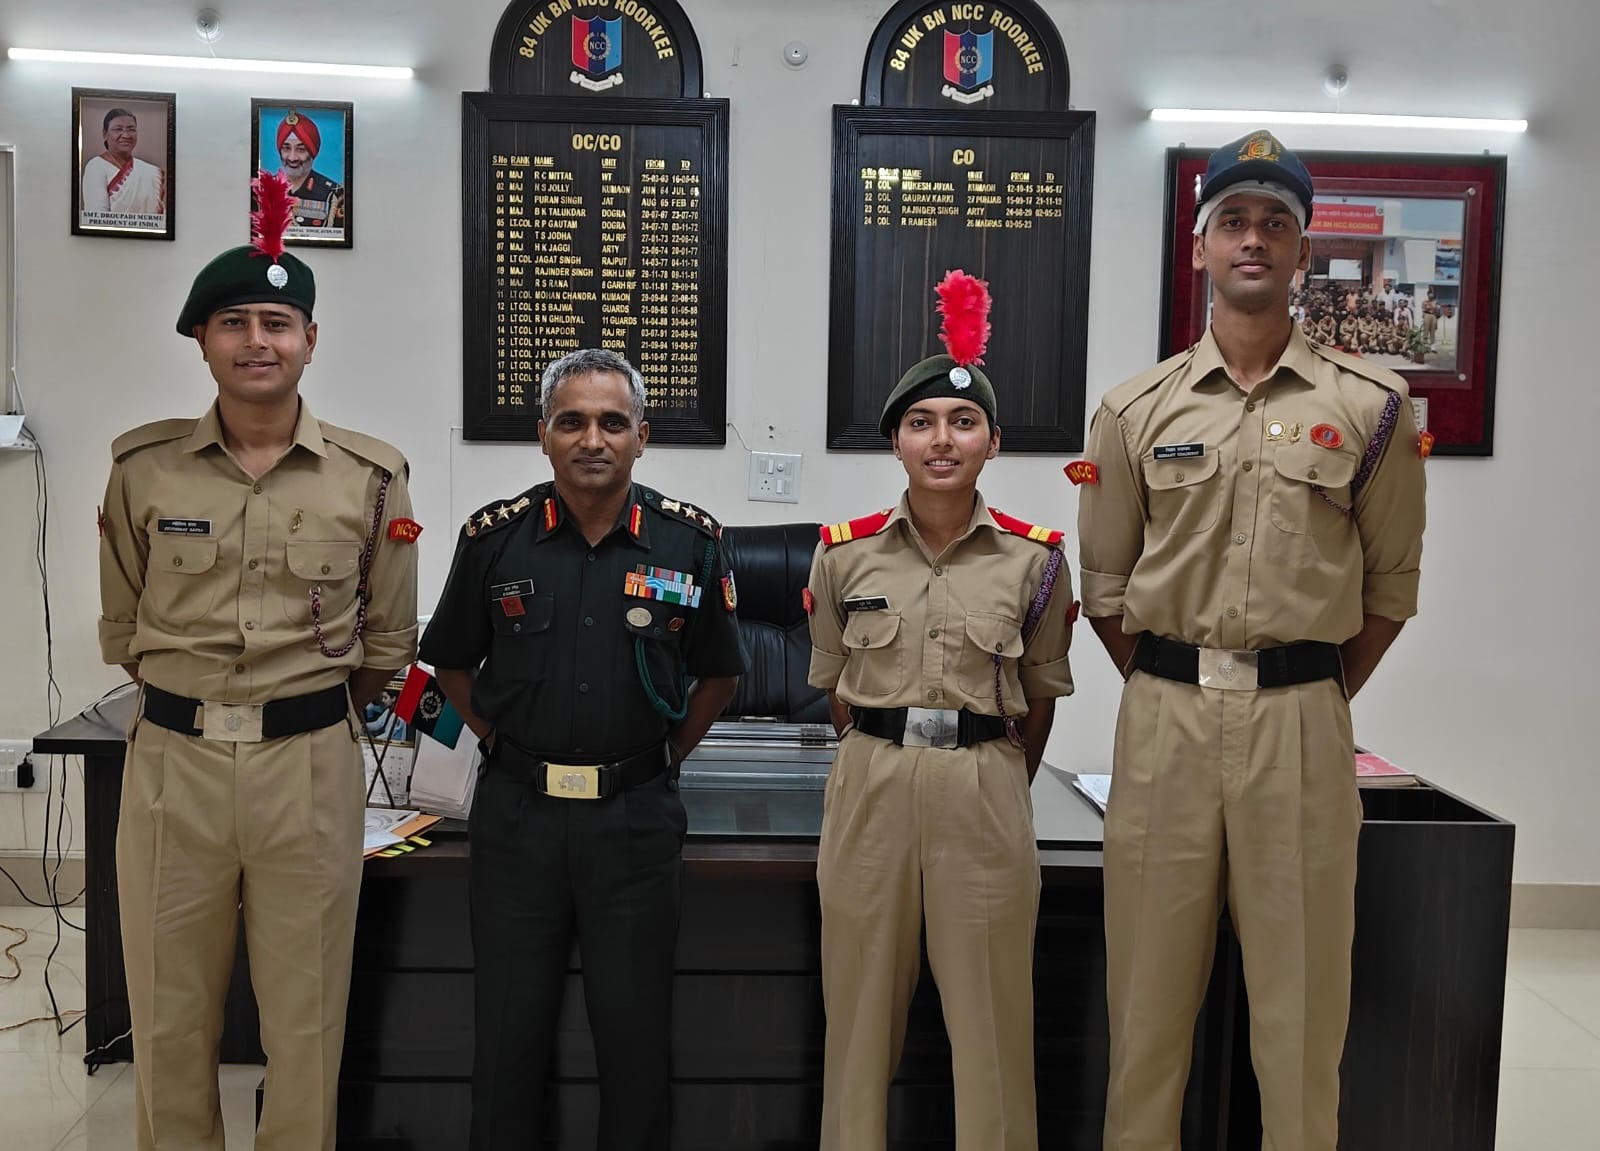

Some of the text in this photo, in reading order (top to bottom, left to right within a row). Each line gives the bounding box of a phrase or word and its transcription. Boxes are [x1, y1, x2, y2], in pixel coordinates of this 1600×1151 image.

[519, 0, 674, 60] 84 UK BN ROORKEE
[890, 4, 1044, 74] 84 UK BN NCC ROORKEE
[590, 41, 606, 50] NCC
[961, 55, 976, 63] NCC
[572, 134, 621, 151] OC/CO
[511, 156, 690, 170] RANK NAME FROM TO
[953, 150, 974, 165] CO
[496, 170, 613, 181] 01 MAJ R C MITTAL WT
[903, 169, 1030, 181] NAME FROM
[496, 182, 504, 191] 02
[509, 182, 523, 191] MAJ
[542, 184, 546, 192] S
[548, 184, 570, 192] JOLLY
[642, 186, 656, 195] JUN
[672, 187, 686, 196] JUL
[865, 180, 872, 189] 21
[878, 180, 892, 189] COL
[902, 182, 931, 190] MUKESH
[932, 182, 955, 191] JUYAL
[510, 194, 686, 208] MAJ PURAN SINGH JAT AUG FEB
[865, 193, 872, 201] 22
[878, 193, 891, 202] COL
[902, 194, 930, 203] GAURAV
[932, 195, 954, 203] KARKI
[967, 196, 975, 204] 27
[496, 206, 504, 215] 04
[510, 206, 524, 215] MAJ
[542, 208, 547, 216] K
[548, 208, 586, 217] TALUKDAR
[602, 209, 626, 218] DOGRA
[864, 205, 985, 216] 23 COL RAJINDER SINGH ARTY
[496, 219, 504, 227] 05
[534, 220, 540, 229] R
[542, 220, 546, 229] P
[548, 220, 578, 229] GAUTAM
[602, 221, 626, 230] DOGRA
[864, 217, 872, 225] 24
[877, 217, 890, 225] COL
[901, 218, 907, 226] R
[908, 218, 938, 226] RAMESH
[975, 220, 1002, 228] MADRAS
[510, 230, 524, 239] MAJ
[535, 231, 539, 240] T
[541, 231, 546, 240] S
[548, 232, 572, 240] JODHA
[602, 233, 615, 242] RAJ
[616, 233, 627, 242] RIF
[496, 243, 620, 254] 07 MAJ H K JAGGI ARTY
[518, 254, 532, 263] COL
[534, 256, 558, 264] JAGAT
[560, 256, 582, 265] SINGH
[602, 257, 627, 266] RAJPUT
[510, 267, 618, 278] MAJ RAJINDER SINGH SIKH
[510, 278, 524, 287] MAJ
[535, 279, 540, 288] R
[542, 279, 547, 288] S
[548, 280, 568, 288] RANA
[607, 281, 626, 290] GARH
[518, 290, 532, 299] COL
[535, 291, 560, 300] MOHAN
[562, 292, 597, 300] CHANDRA
[602, 293, 630, 301] KUMAON
[497, 302, 629, 313] 12 COL S S BAJWA GUARDS
[497, 314, 504, 322] 13
[518, 314, 532, 323] COL
[535, 315, 540, 324] R
[542, 315, 547, 324] N
[548, 315, 585, 324] GHILDIYAL
[602, 316, 608, 325] 11
[610, 316, 637, 325] GUARDS
[497, 326, 504, 334] 14
[518, 326, 532, 335] COL
[540, 327, 544, 336] P
[546, 327, 576, 336] KAPOOR
[602, 328, 615, 337] RAJ
[616, 328, 627, 337] RIF
[498, 338, 626, 348] 15 COL R P S KUNDU DOGRA
[518, 350, 532, 358] COL
[535, 350, 540, 359] J
[541, 350, 546, 359] R
[498, 361, 505, 370] 17
[518, 361, 532, 370] COL
[535, 362, 540, 370] R
[518, 373, 532, 382] COL
[510, 385, 524, 393] COL
[510, 397, 524, 405] COL
[1070, 464, 1092, 480] NCC
[395, 524, 417, 538] NCC
